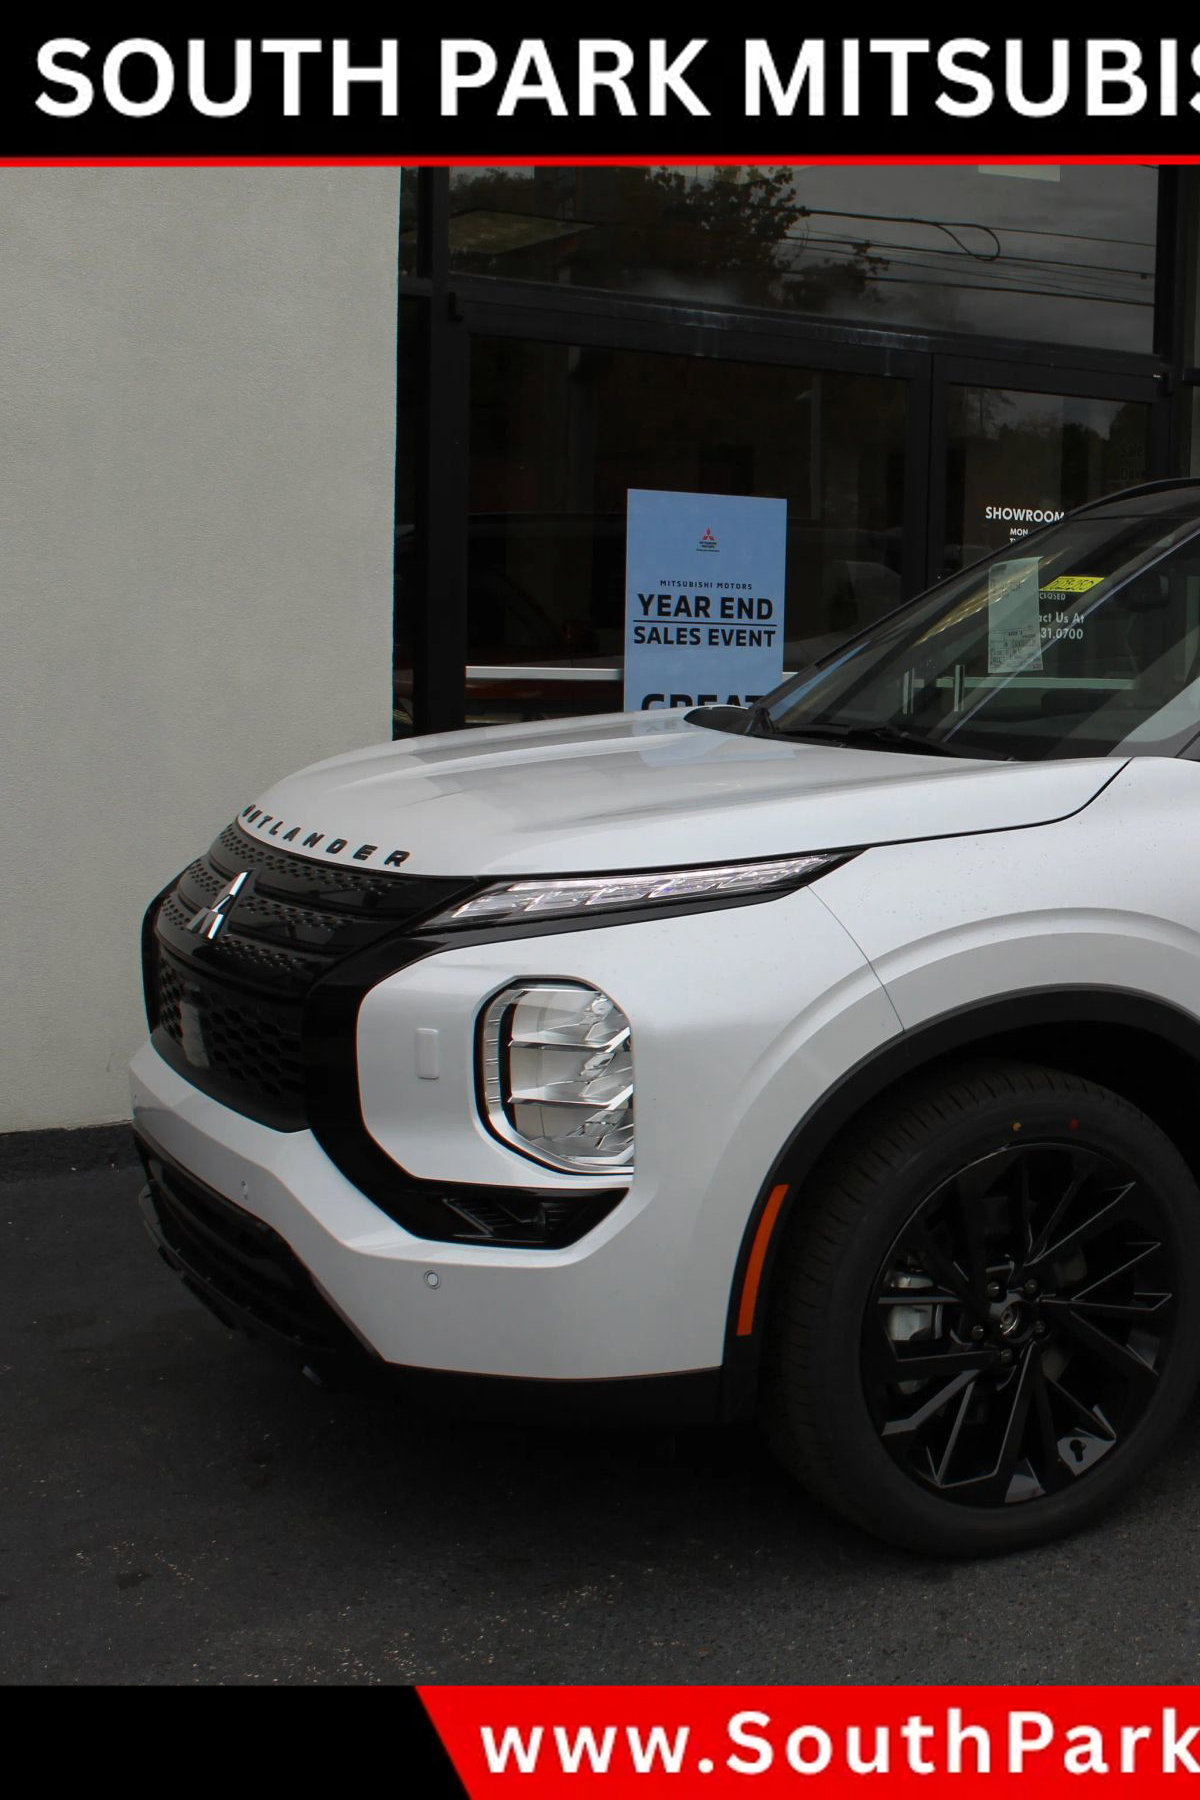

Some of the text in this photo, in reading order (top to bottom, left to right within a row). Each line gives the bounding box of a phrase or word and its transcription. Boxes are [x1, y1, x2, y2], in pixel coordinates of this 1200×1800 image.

[659, 579, 753, 590] MITSUBISHI MOTORS
[637, 593, 773, 620] YEAR END
[1055, 611, 1069, 624] Us
[1073, 612, 1084, 624] At
[633, 625, 776, 647] SALES EVENT
[242, 804, 411, 867] OUTLANDER
